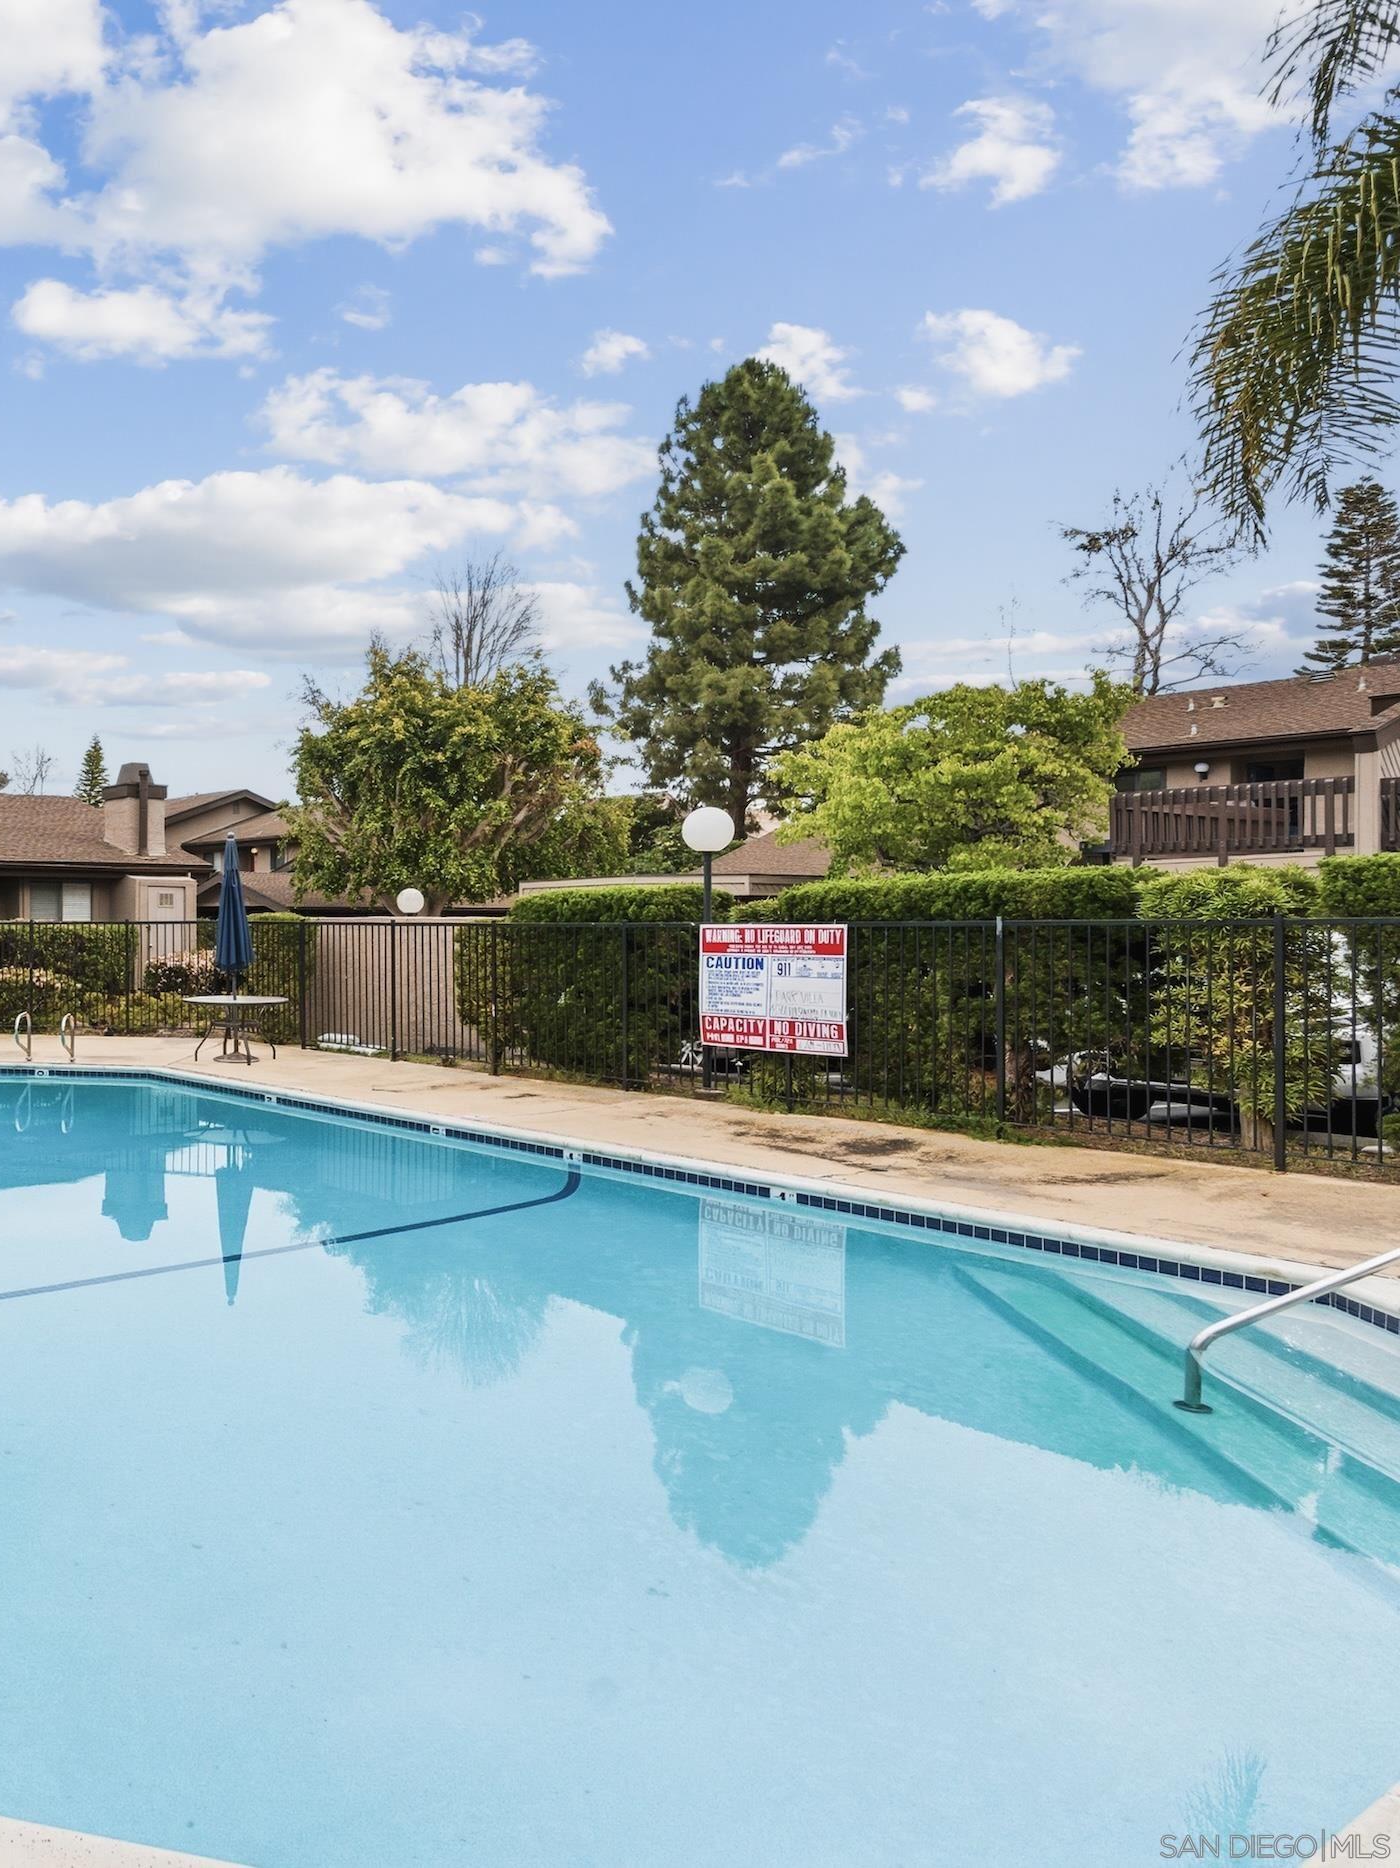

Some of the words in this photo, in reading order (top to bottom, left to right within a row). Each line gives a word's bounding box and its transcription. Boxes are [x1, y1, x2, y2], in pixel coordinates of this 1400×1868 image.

[744, 929, 756, 944] NO
[757, 929, 802, 944] LIFEGUARD
[803, 929, 816, 944] ON
[818, 929, 842, 945] DUTY
[706, 956, 764, 970] CAUTION
[777, 963, 791, 976] 911
[705, 1016, 764, 1034] CAPACITY
[774, 1020, 789, 1035] NO
[795, 1022, 839, 1039] DIVING
